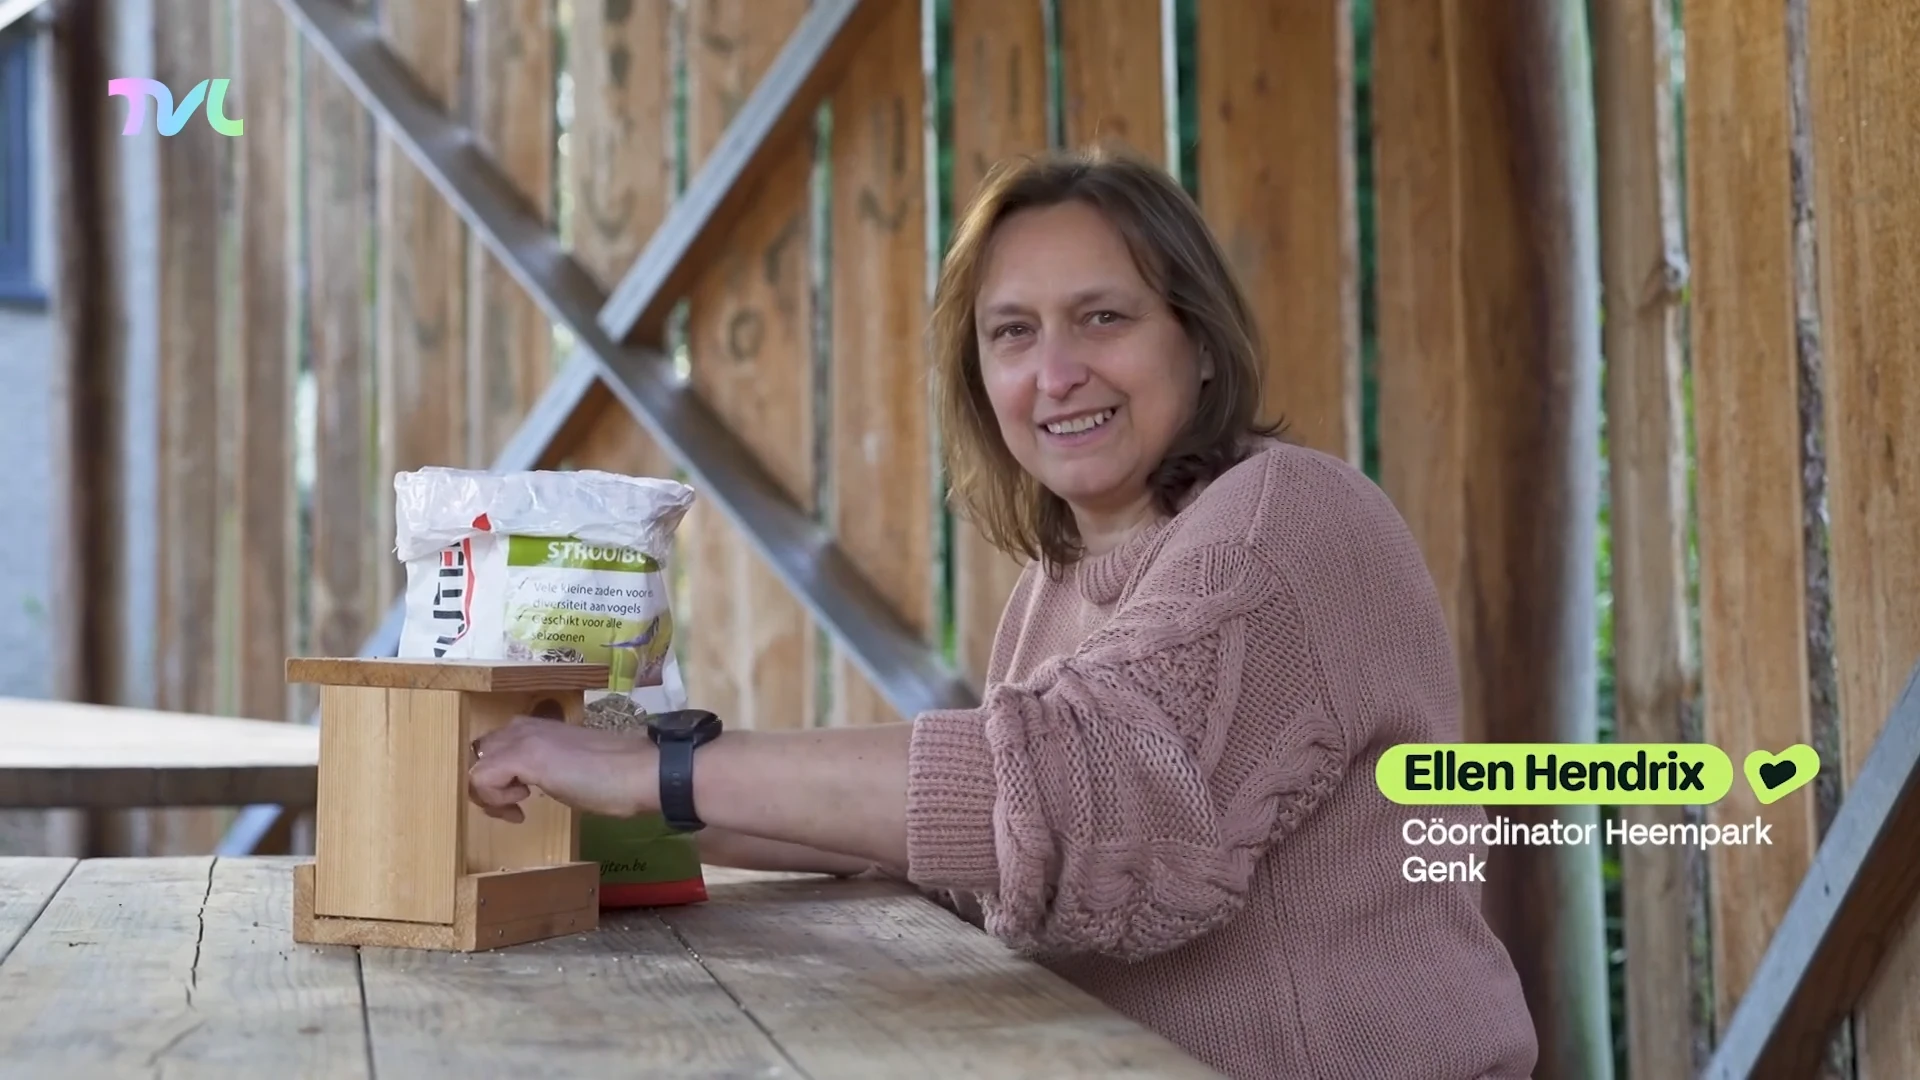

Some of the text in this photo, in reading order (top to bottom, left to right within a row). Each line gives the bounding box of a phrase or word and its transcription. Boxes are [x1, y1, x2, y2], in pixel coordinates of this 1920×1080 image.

[534, 582, 557, 593] Vele
[561, 582, 594, 596] kleine
[533, 599, 641, 615] diversiteit aan vogels
[531, 614, 623, 629] Geschikt voor alle
[531, 630, 585, 643] seizoenen
[600, 858, 648, 876] ijten.be
